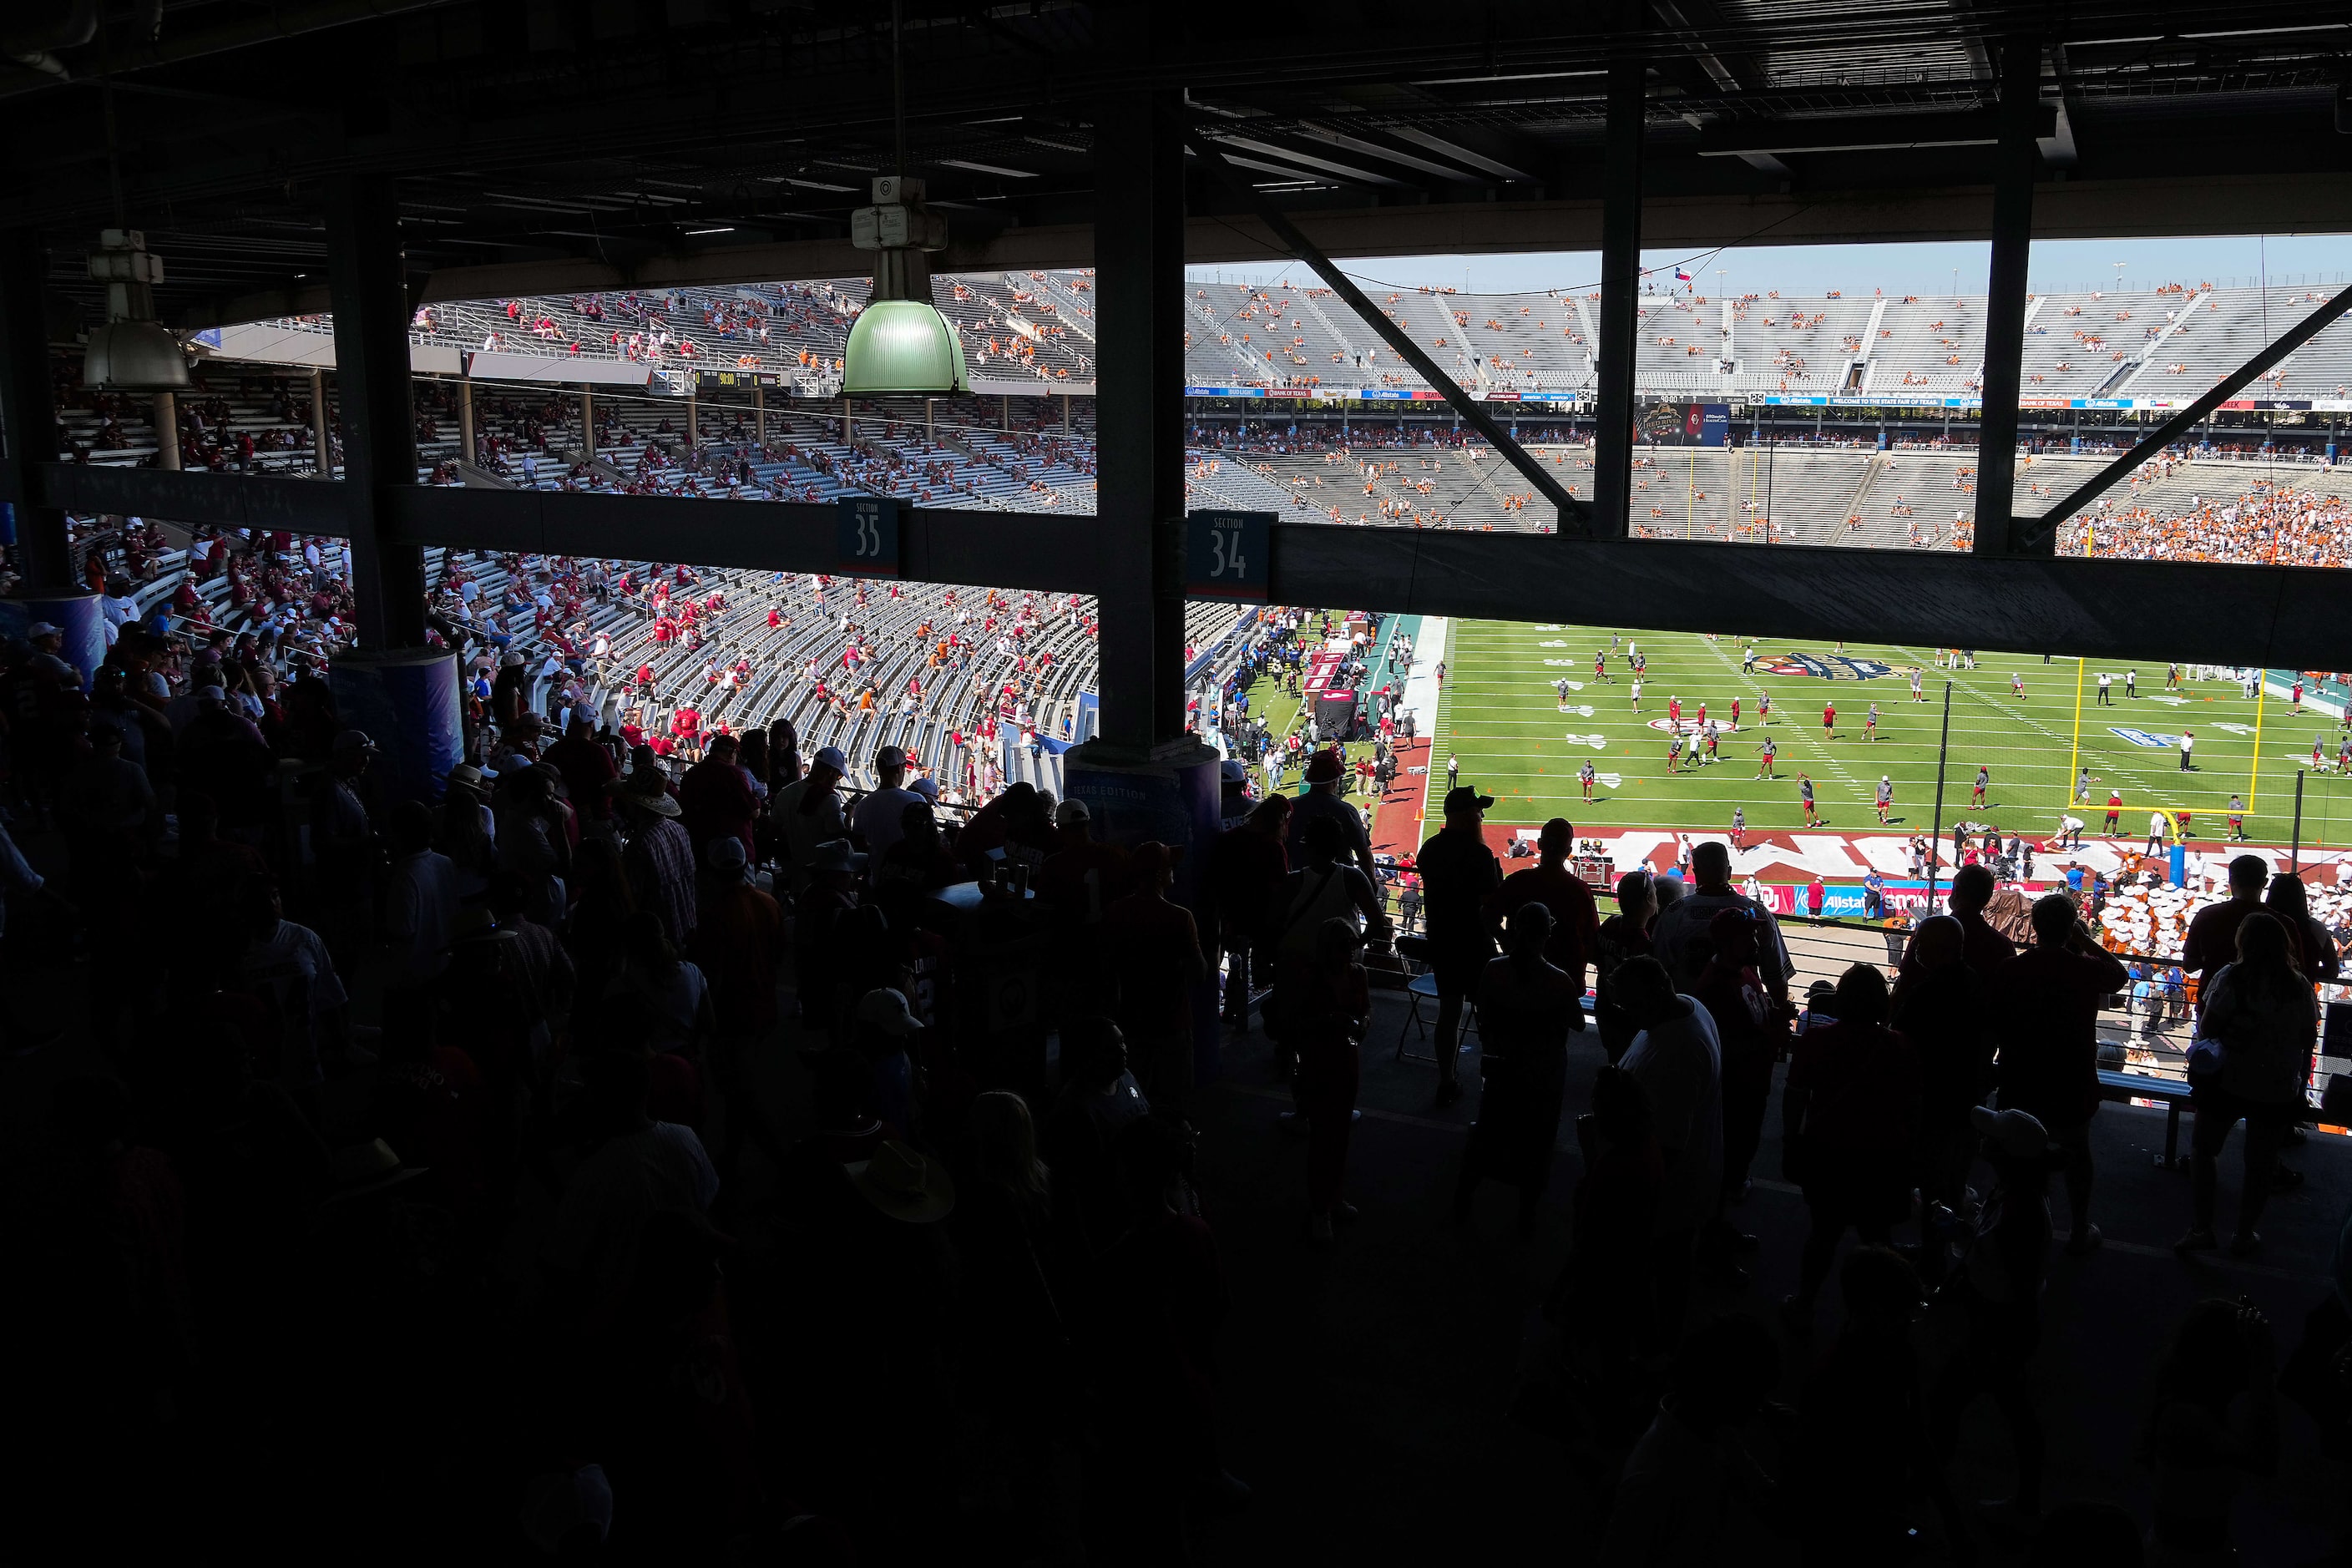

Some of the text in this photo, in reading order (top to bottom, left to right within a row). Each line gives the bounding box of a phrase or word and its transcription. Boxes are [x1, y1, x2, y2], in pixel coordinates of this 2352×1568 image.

[720, 372, 735, 386] 90:00
[1661, 395, 1678, 403] 90:00
[1751, 394, 1763, 403] 25
[1646, 420, 1661, 428] RED
[856, 503, 878, 513] SECTION
[1214, 518, 1243, 529] SECTION
[855, 513, 880, 557] 35
[1210, 529, 1247, 579] 34
[1073, 785, 1147, 802] TEXAS EDITION
[1823, 893, 1867, 908] Allstat
